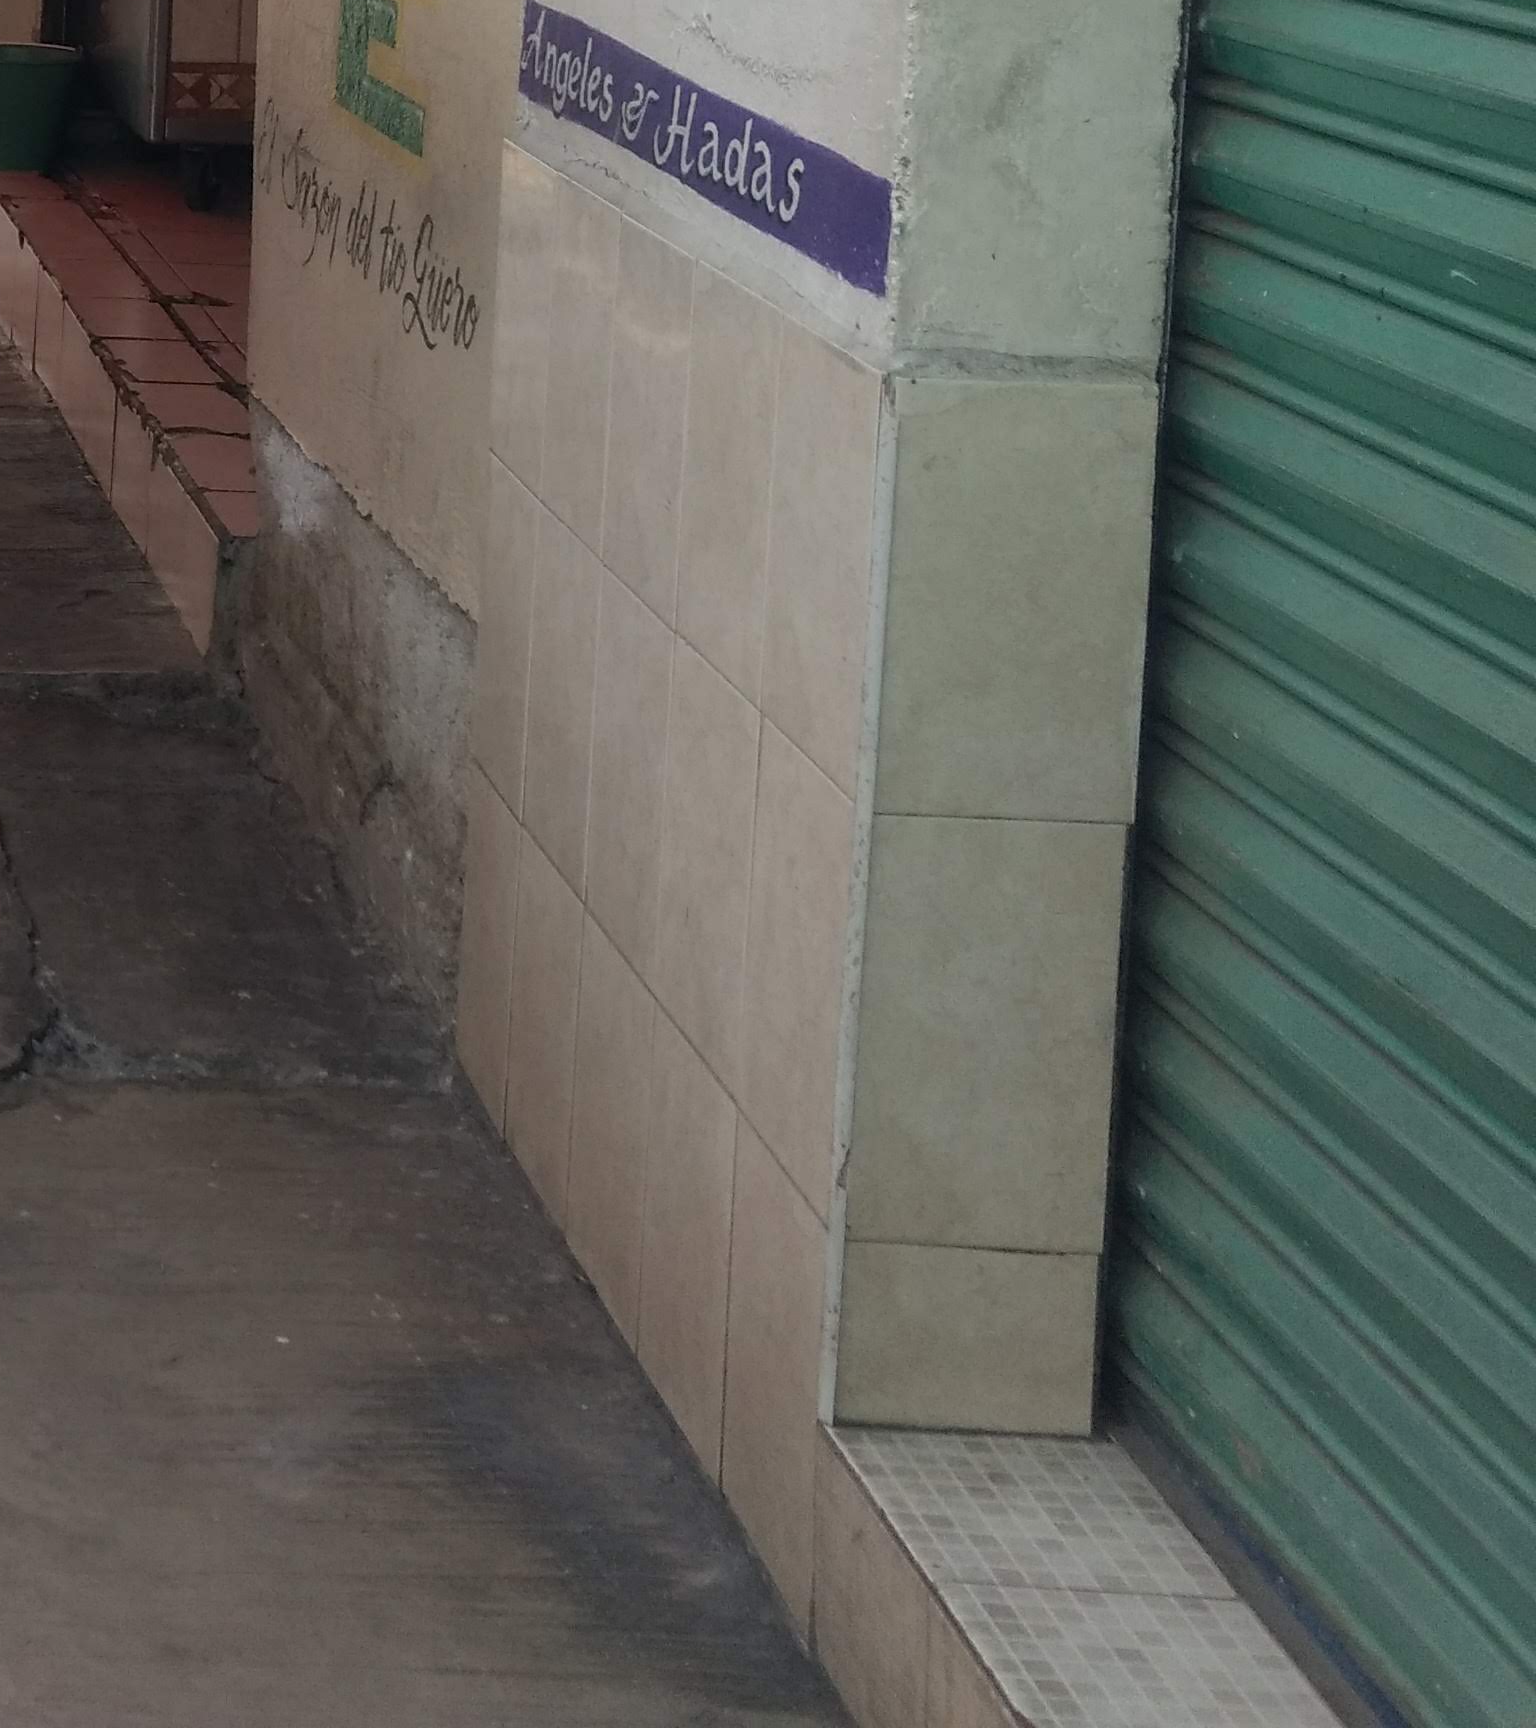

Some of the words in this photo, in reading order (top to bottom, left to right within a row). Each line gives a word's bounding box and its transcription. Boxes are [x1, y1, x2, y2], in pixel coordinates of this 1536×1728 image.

[520, 10, 614, 124] Angeles
[653, 84, 806, 223] Hadas
[346, 179, 378, 280] del
[402, 213, 479, 351] Güero
